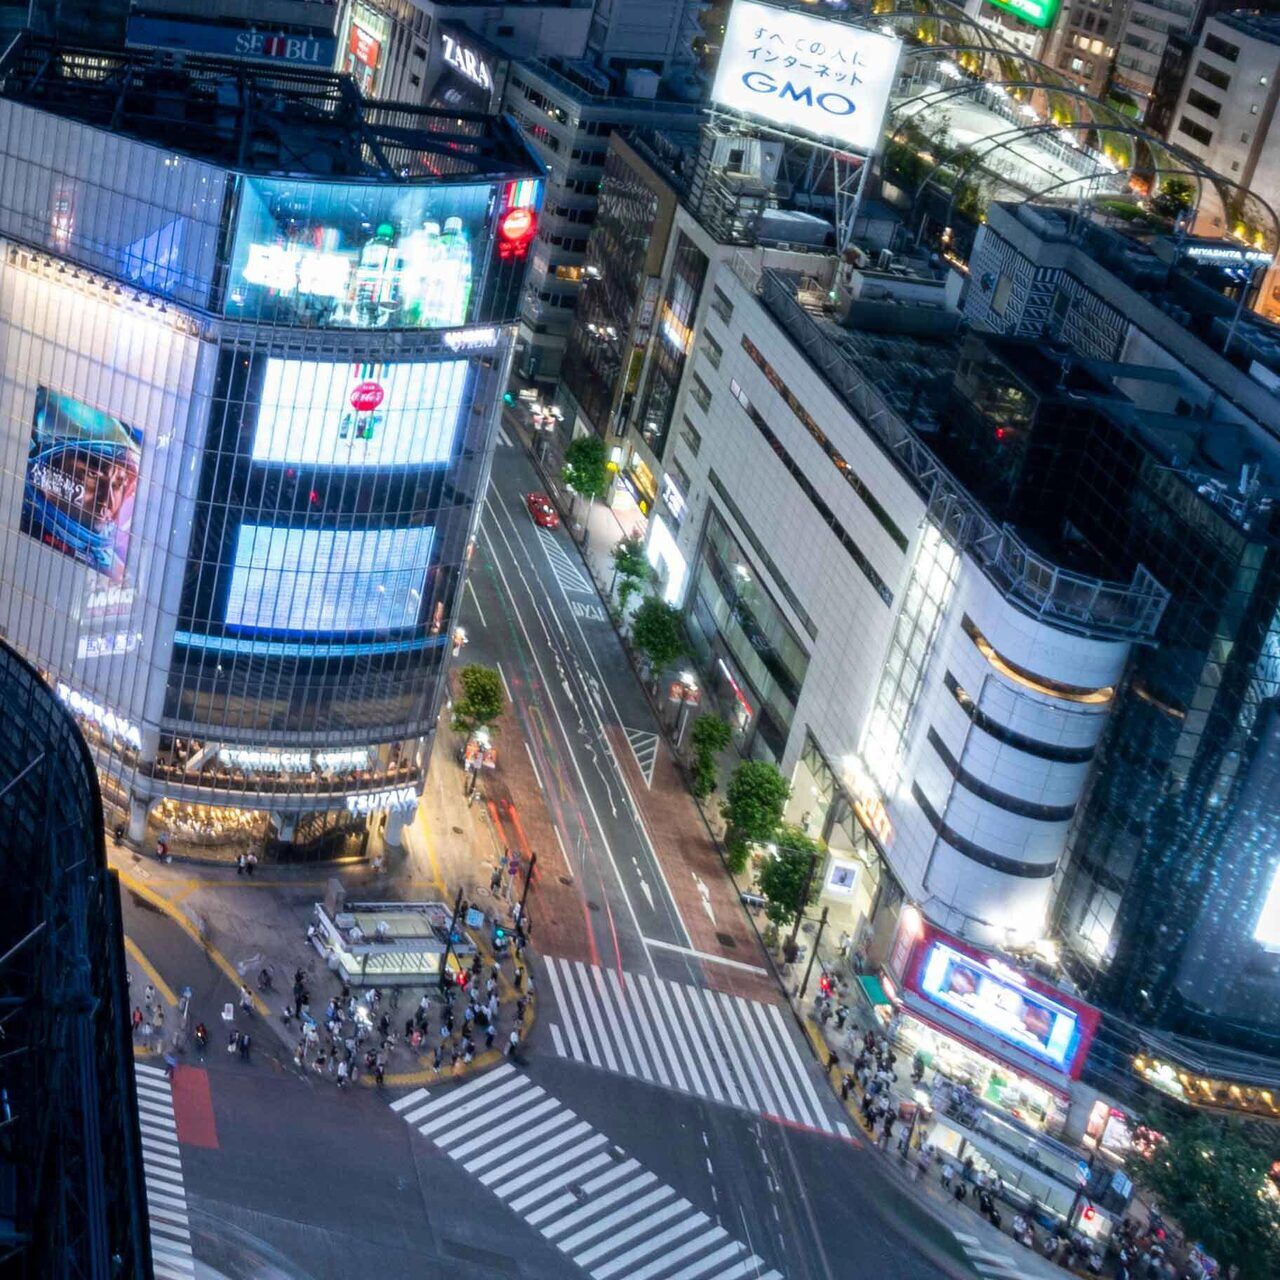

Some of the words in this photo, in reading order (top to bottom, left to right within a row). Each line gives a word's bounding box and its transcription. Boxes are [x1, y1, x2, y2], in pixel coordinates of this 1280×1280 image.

[442, 34, 491, 90] ZARA
[747, 46, 863, 86] インターネット
[742, 71, 856, 116] GMO
[1188, 246, 1242, 259] MIYASHITA
[347, 787, 419, 810] TSUTAYA
